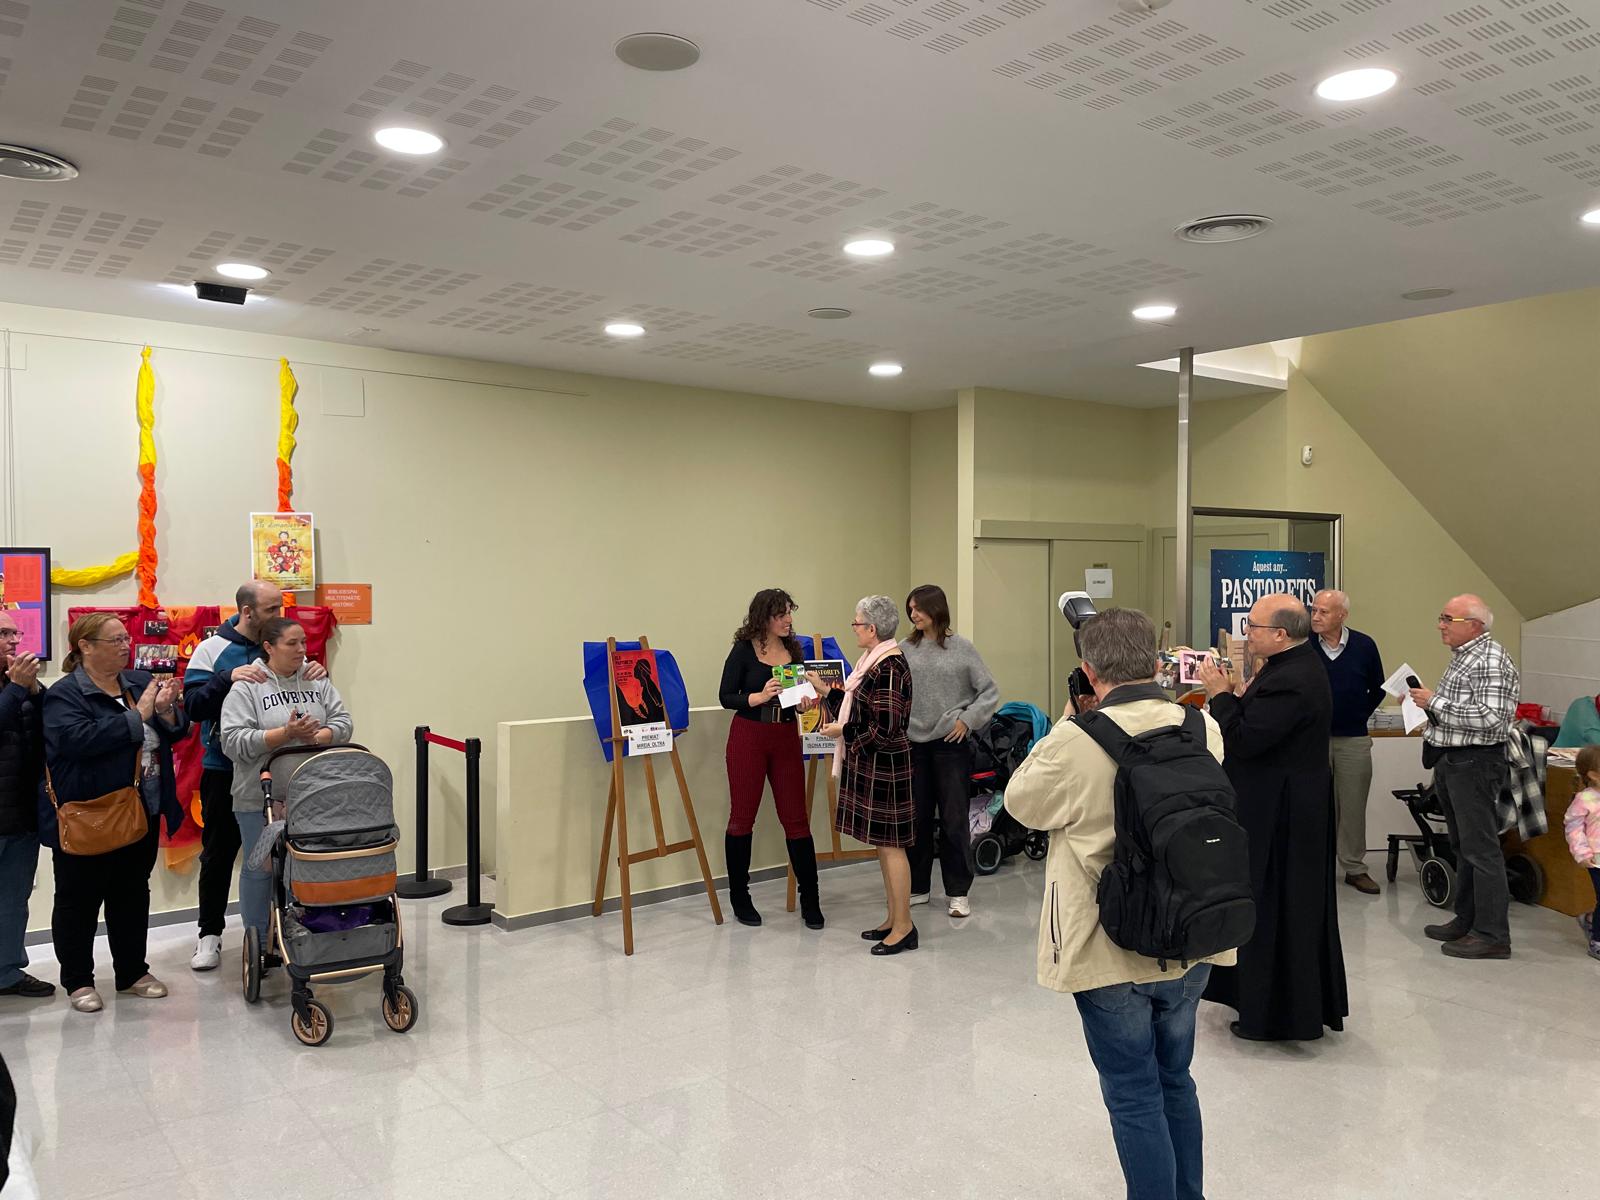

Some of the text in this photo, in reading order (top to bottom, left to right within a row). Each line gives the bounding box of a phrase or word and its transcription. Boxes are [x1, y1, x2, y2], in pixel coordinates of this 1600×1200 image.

[1252, 561, 1272, 573] Aquest
[1221, 578, 1316, 608] PASTORETS
[262, 690, 321, 711] COWBOYS
